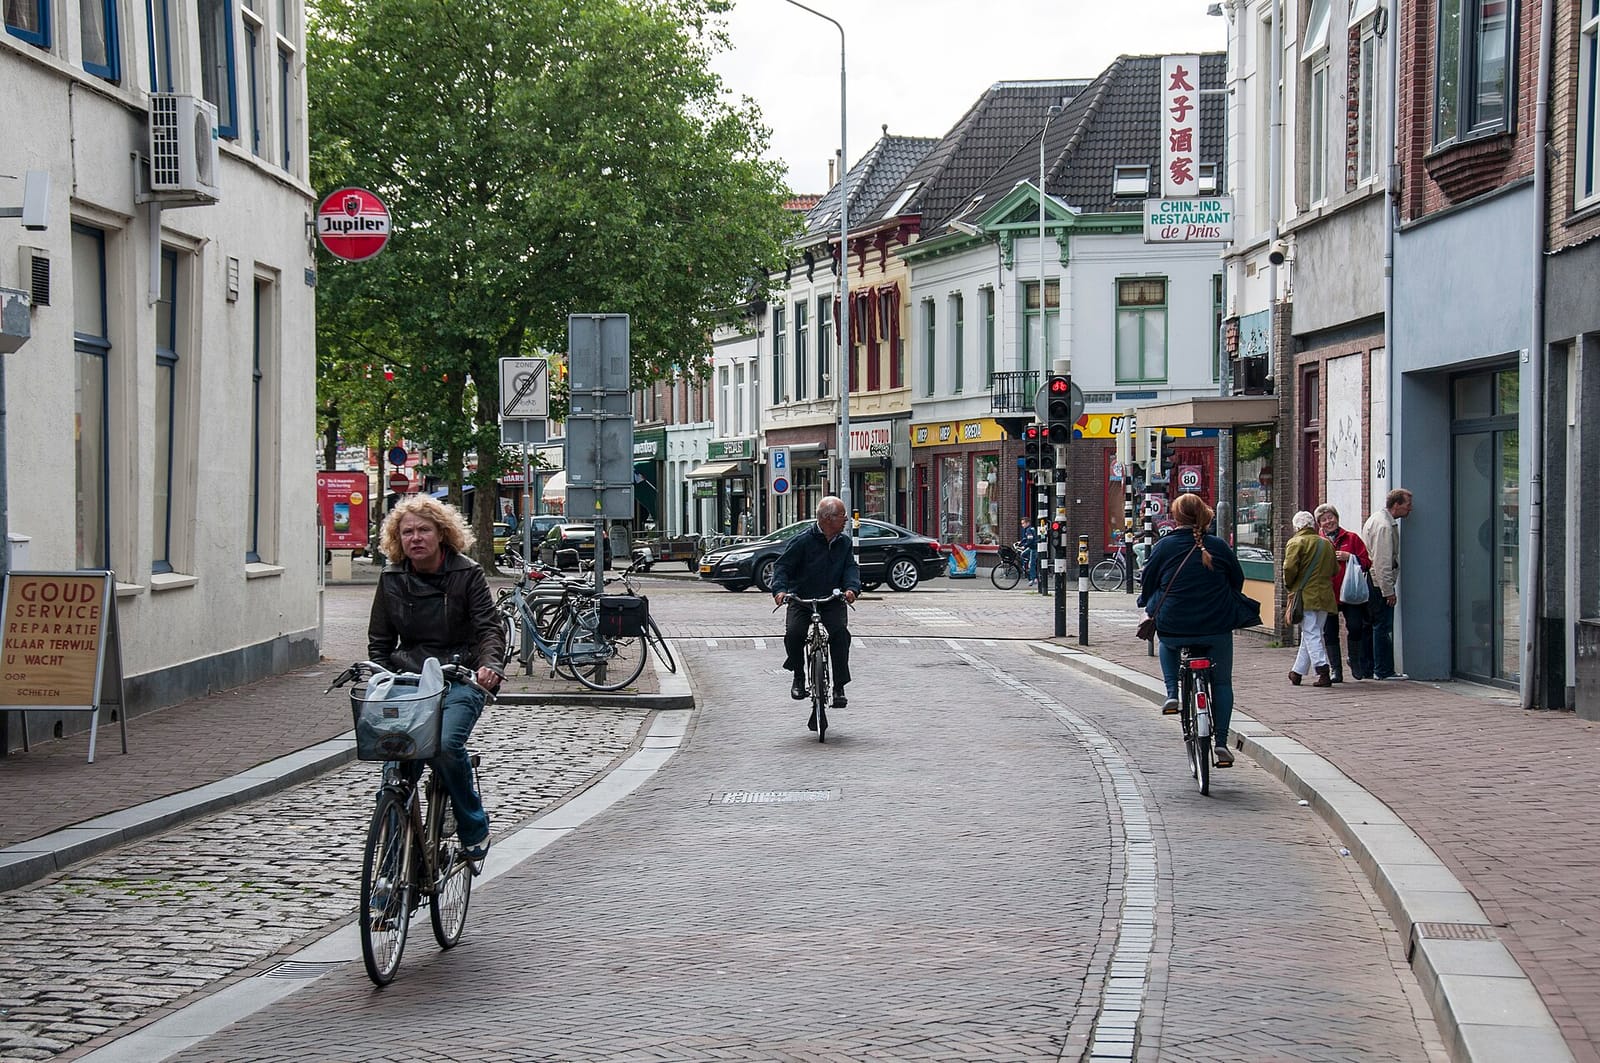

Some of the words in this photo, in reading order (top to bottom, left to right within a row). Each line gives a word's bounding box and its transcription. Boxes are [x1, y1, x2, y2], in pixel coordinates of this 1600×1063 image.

[1168, 65, 1195, 185] 太子酒家
[1151, 212, 1230, 224] RESTAURANT
[323, 217, 384, 234] Jupiler
[1161, 225, 1179, 239] de
[1185, 224, 1220, 240] Prins
[964, 422, 982, 440] BREDA
[776, 453, 784, 463] P
[1376, 459, 1386, 479] 26
[1183, 475, 1196, 484] 80
[21, 582, 96, 602] GOUD
[15, 604, 99, 619] SERVICE
[10, 622, 97, 635] REPARATIE
[5, 638, 45, 650] KLAAR
[49, 639, 96, 650] TERWIJL
[7, 654, 15, 665] U
[24, 655, 64, 666] WACHT
[17, 689, 60, 697] SCHIETEN
